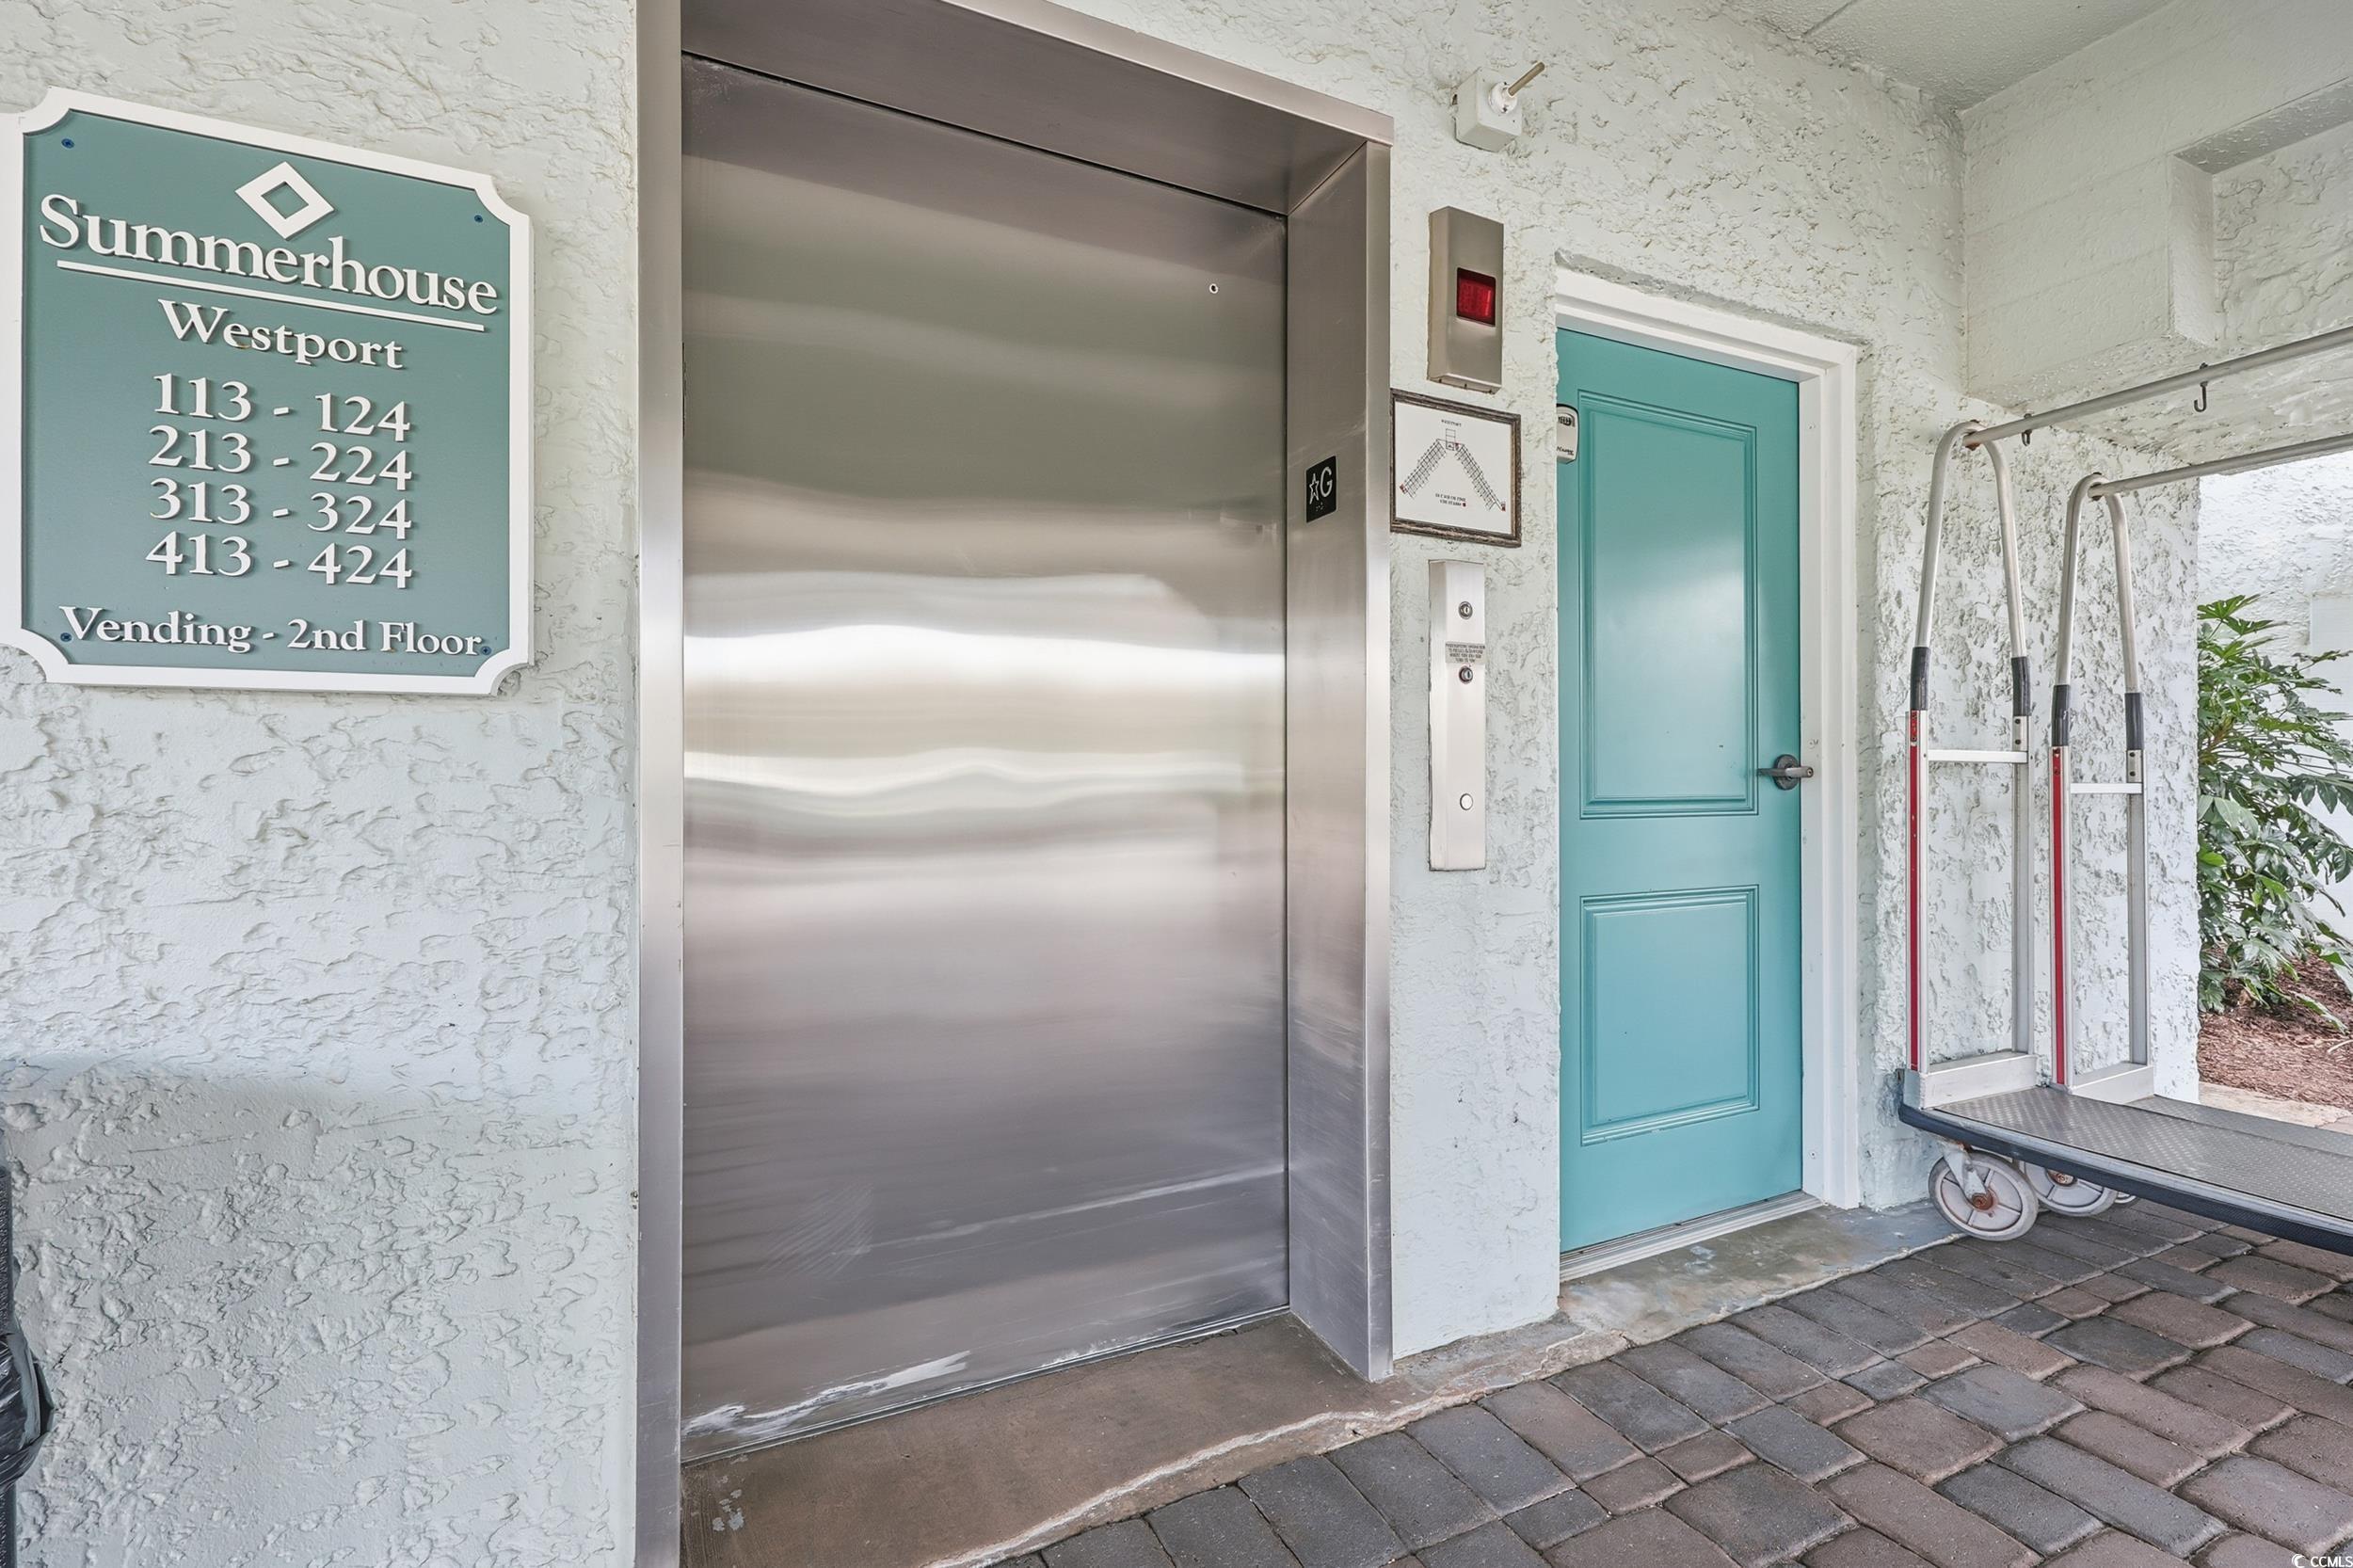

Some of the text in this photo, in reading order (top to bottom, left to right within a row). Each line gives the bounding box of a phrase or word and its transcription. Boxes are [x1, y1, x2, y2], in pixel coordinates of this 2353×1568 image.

[40, 194, 499, 315] Summerhouse
[158, 298, 404, 370] Westport
[153, 374, 411, 441] 113 - 124
[148, 424, 412, 490] 213 - 224
[1321, 467, 1333, 497] G
[150, 478, 412, 539] 313 - 324
[145, 531, 412, 589] 413 - 424
[58, 605, 482, 656] Vending - 2nd Floor
